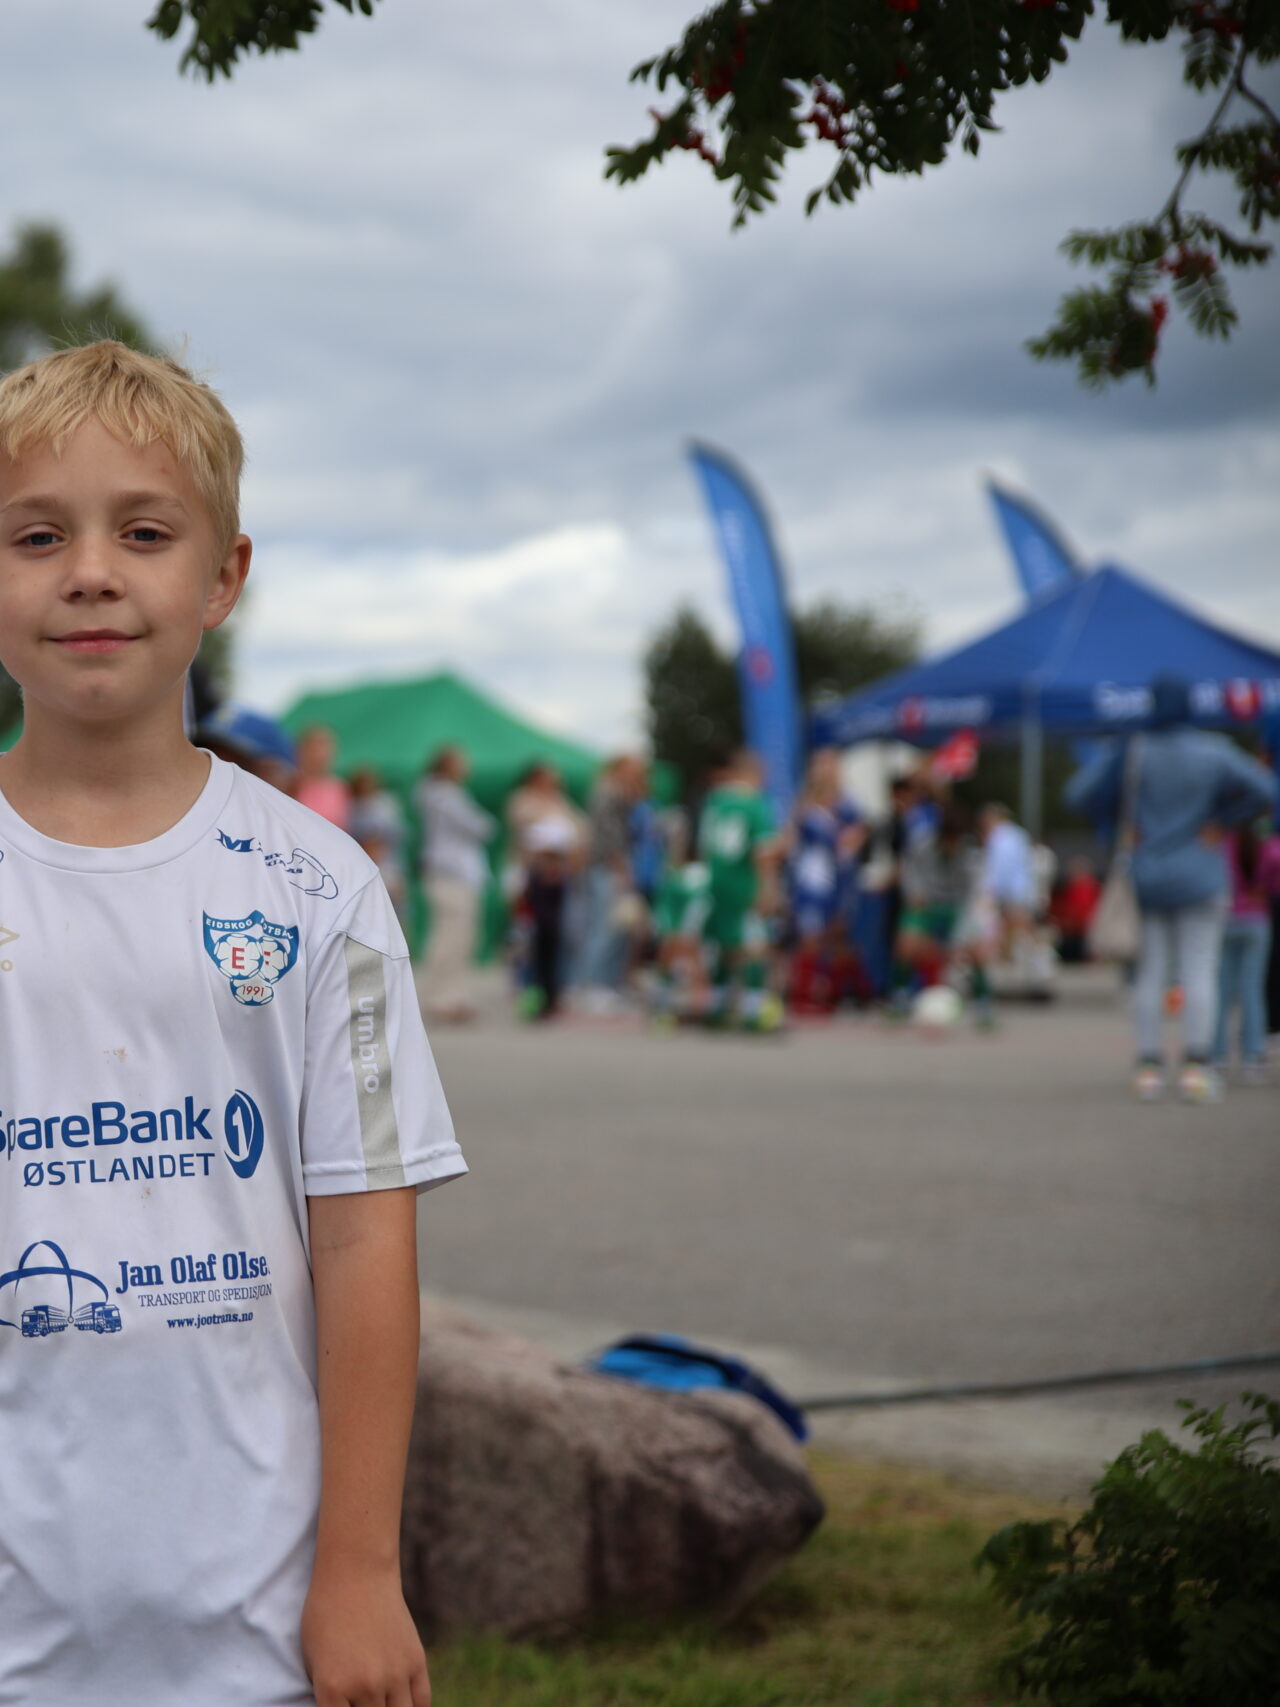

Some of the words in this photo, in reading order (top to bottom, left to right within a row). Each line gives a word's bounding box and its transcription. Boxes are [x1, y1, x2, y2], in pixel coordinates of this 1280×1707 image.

[231, 946, 246, 970] E
[241, 985, 265, 997] 1991
[357, 995, 382, 1094] umbro
[23, 1152, 216, 1188] ØSTLANDET
[115, 1261, 164, 1294] Jan
[170, 1253, 217, 1284] Olaf
[222, 1251, 271, 1281] Olse
[138, 1290, 206, 1308] TRANSPORT
[207, 1289, 221, 1303] OG
[223, 1283, 273, 1301] SPEDISJON
